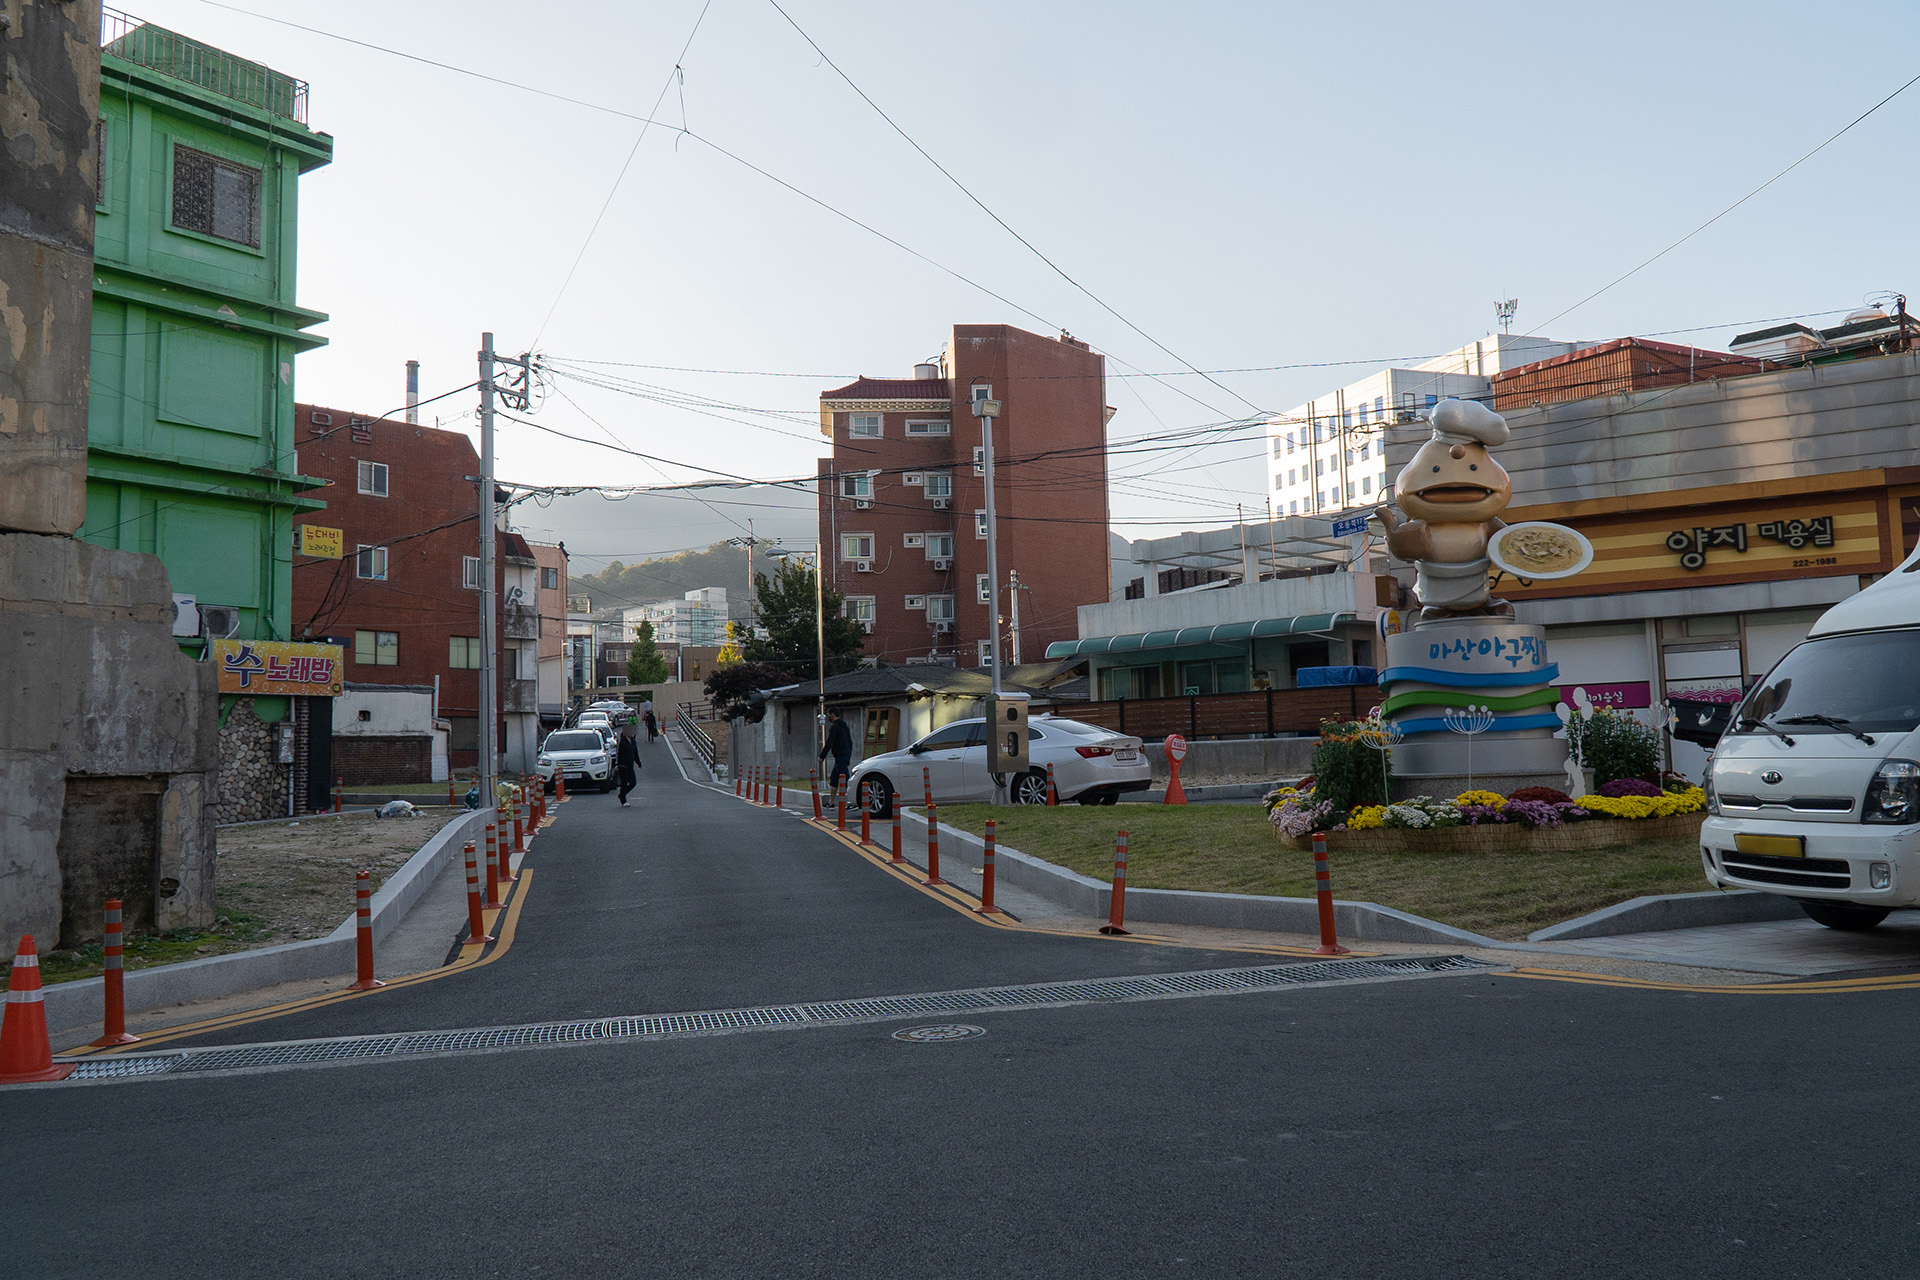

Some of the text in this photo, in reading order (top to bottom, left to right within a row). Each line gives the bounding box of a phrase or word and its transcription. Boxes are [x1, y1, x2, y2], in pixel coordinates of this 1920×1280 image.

[306, 527, 339, 545] 뉴대빈
[1666, 516, 1834, 571] 양지 미용실
[1793, 557, 1837, 567] 222-1986
[223, 643, 333, 688] 수 노래방
